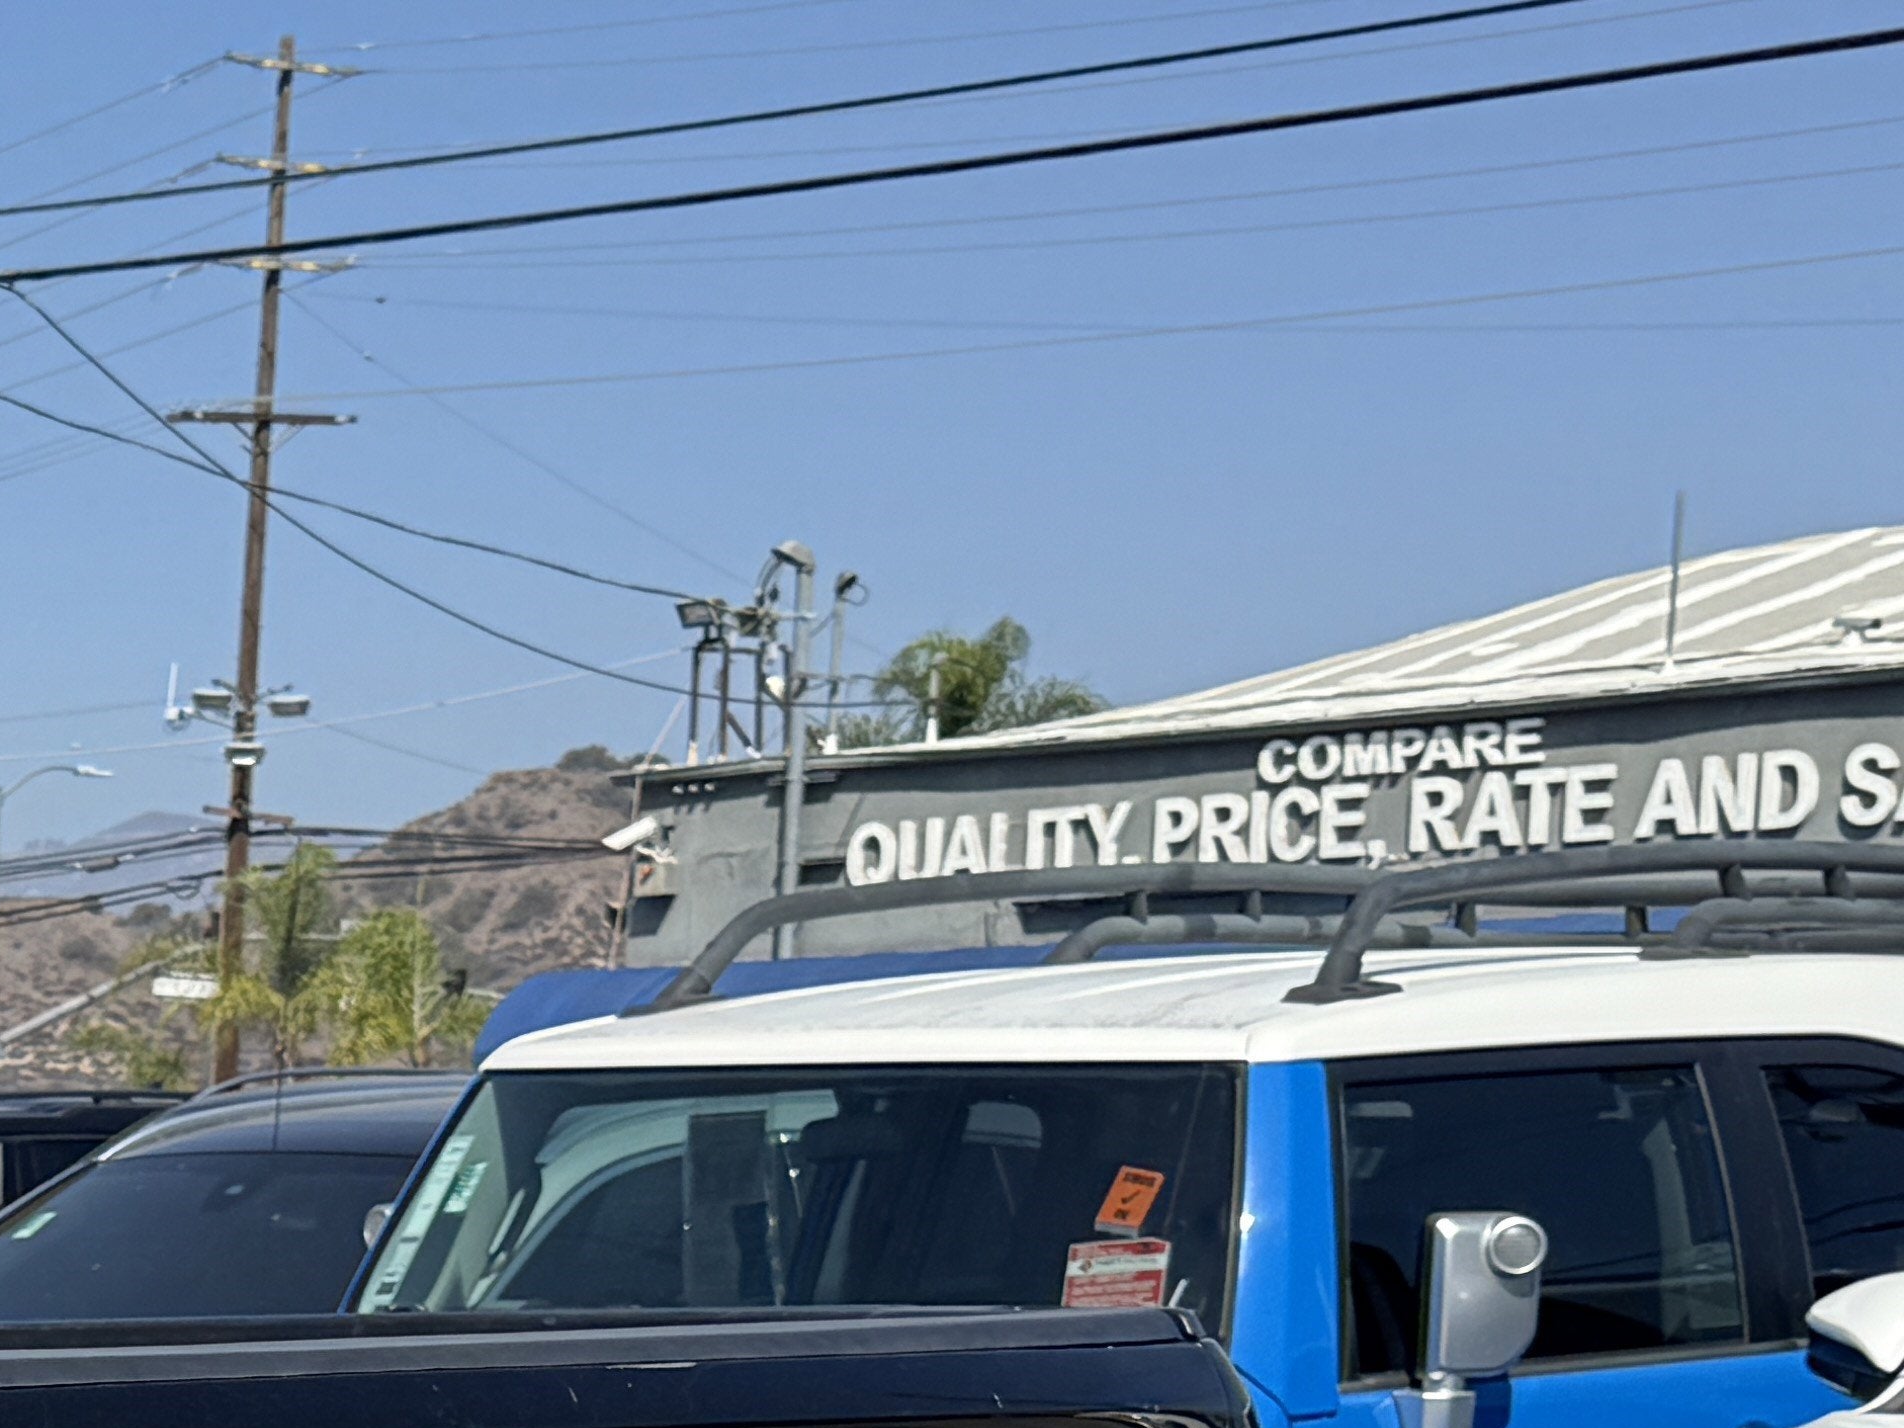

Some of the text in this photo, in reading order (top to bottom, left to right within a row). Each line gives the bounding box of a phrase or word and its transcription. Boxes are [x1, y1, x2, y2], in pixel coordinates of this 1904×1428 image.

[1257, 717, 1547, 784] COMPARE
[1152, 783, 1387, 870] PRICE,
[1408, 763, 1618, 853] RATE
[1633, 748, 1820, 839] AND
